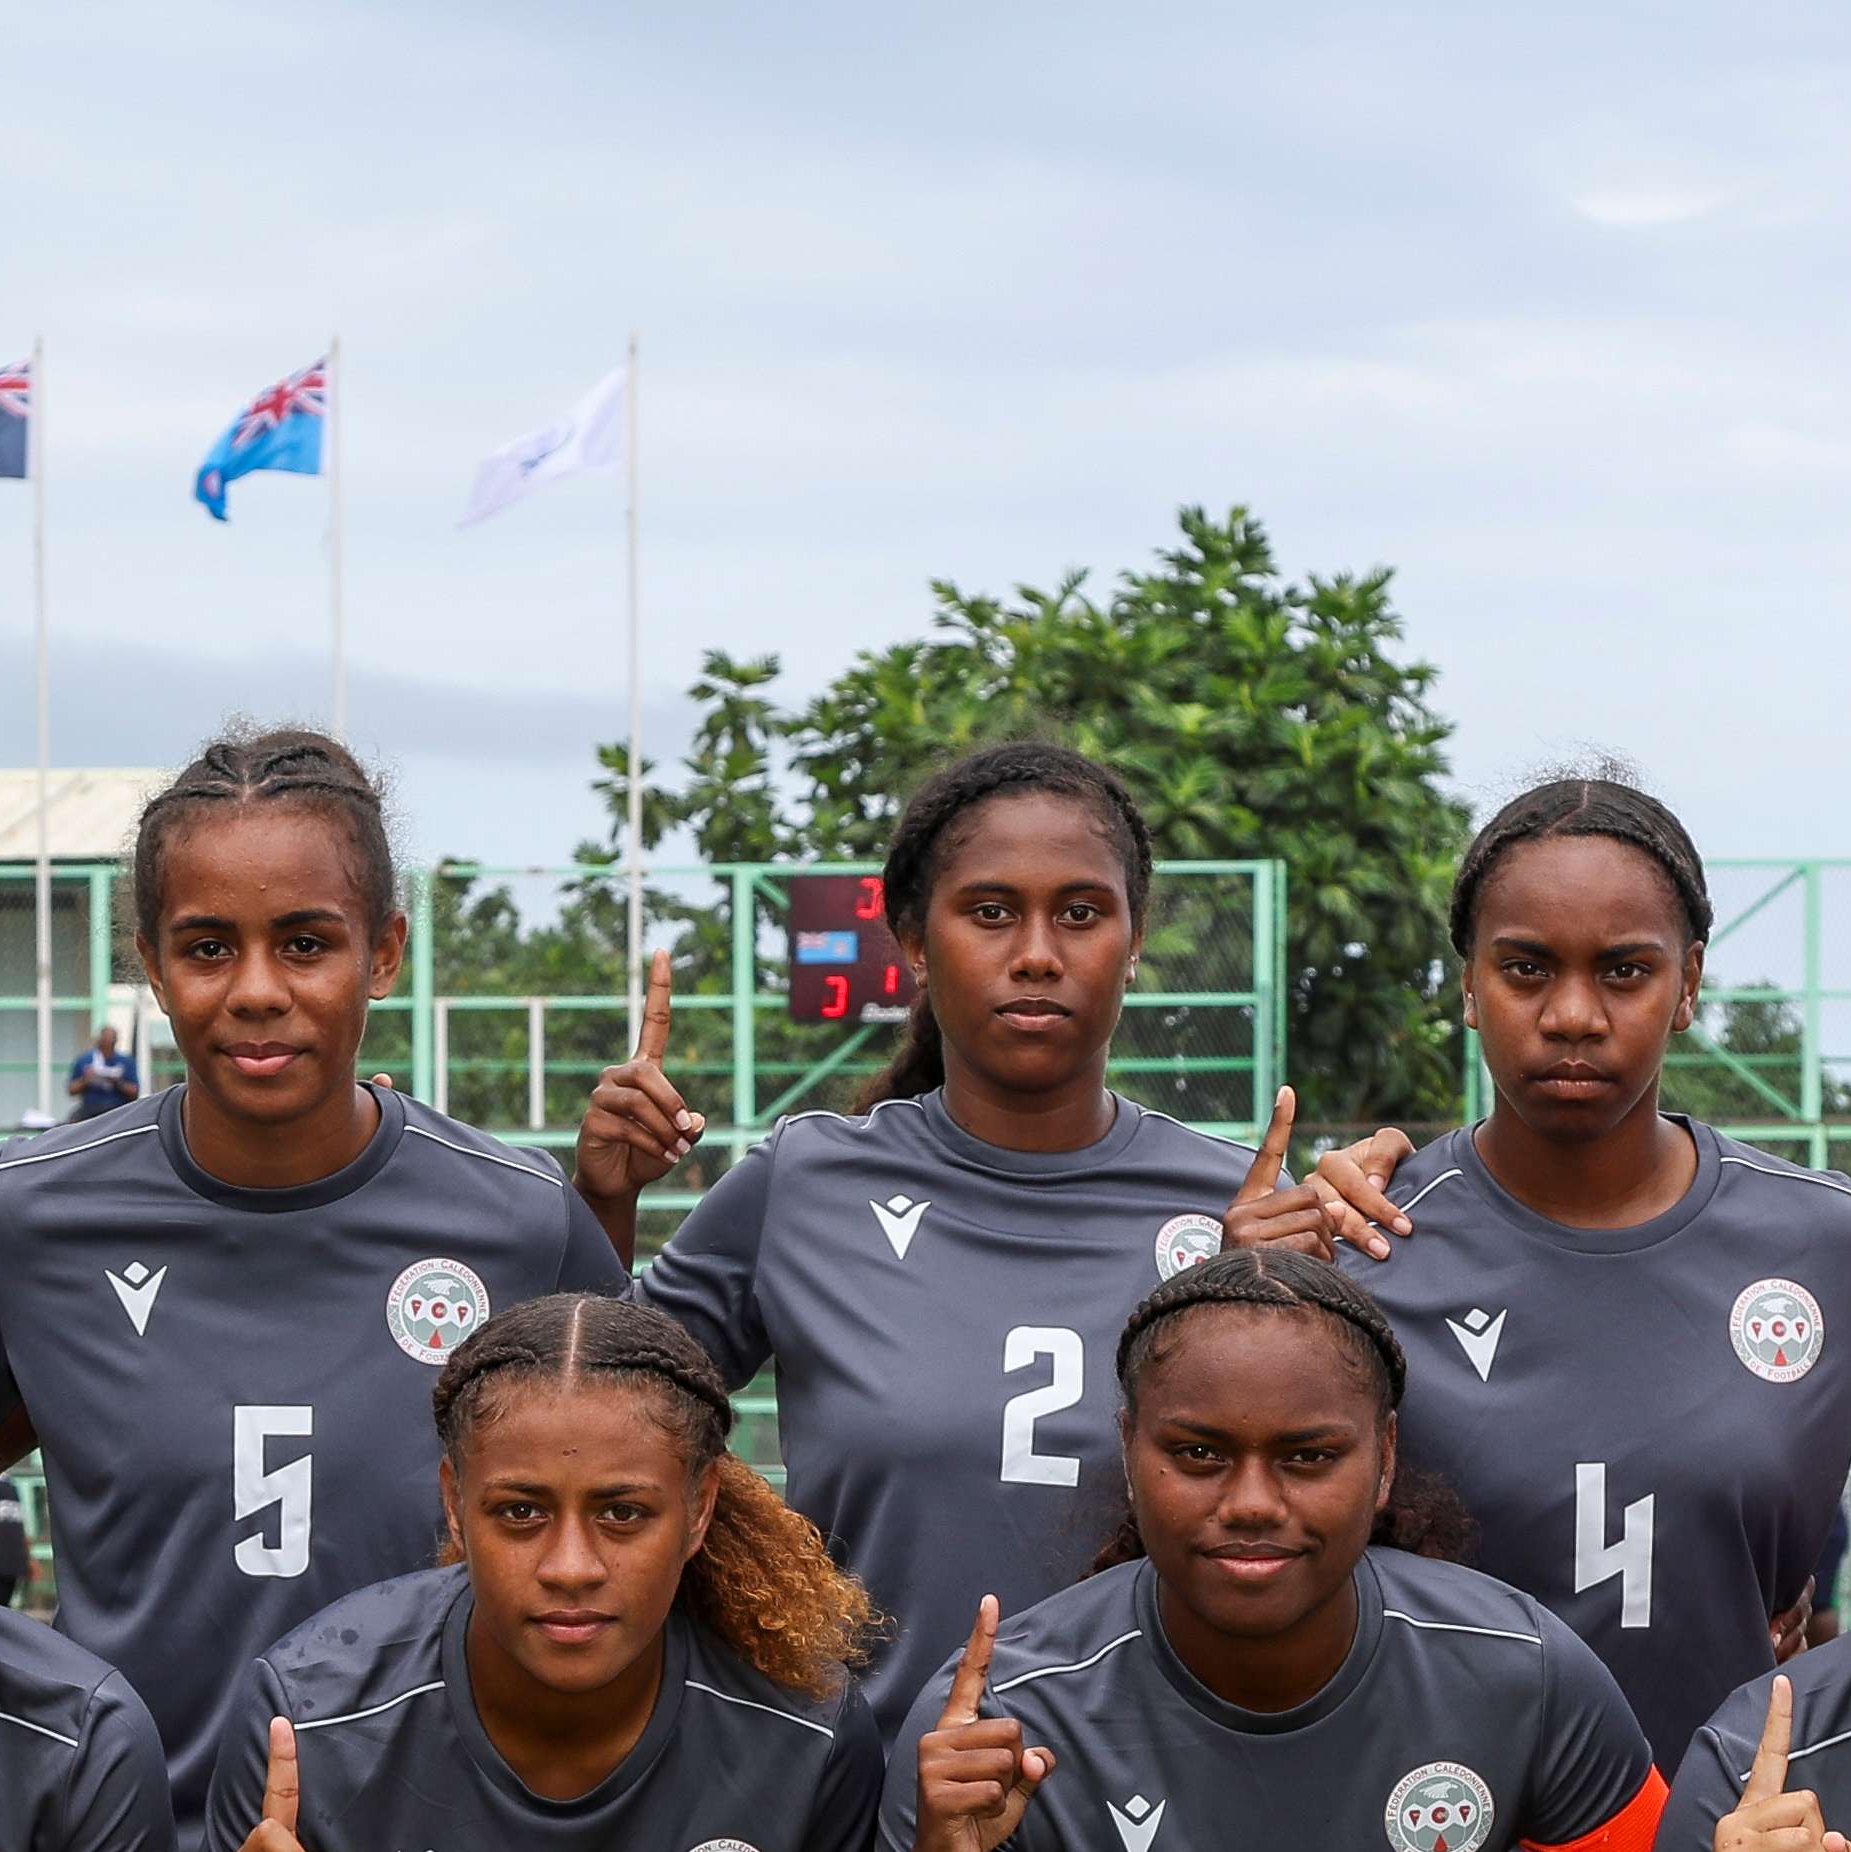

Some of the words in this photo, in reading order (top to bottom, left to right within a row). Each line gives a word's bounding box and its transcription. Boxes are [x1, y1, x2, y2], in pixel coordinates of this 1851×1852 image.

[1000, 1325, 1084, 1487] 2
[233, 1404, 314, 1577] 5
[1574, 1462, 1655, 1628] 4
